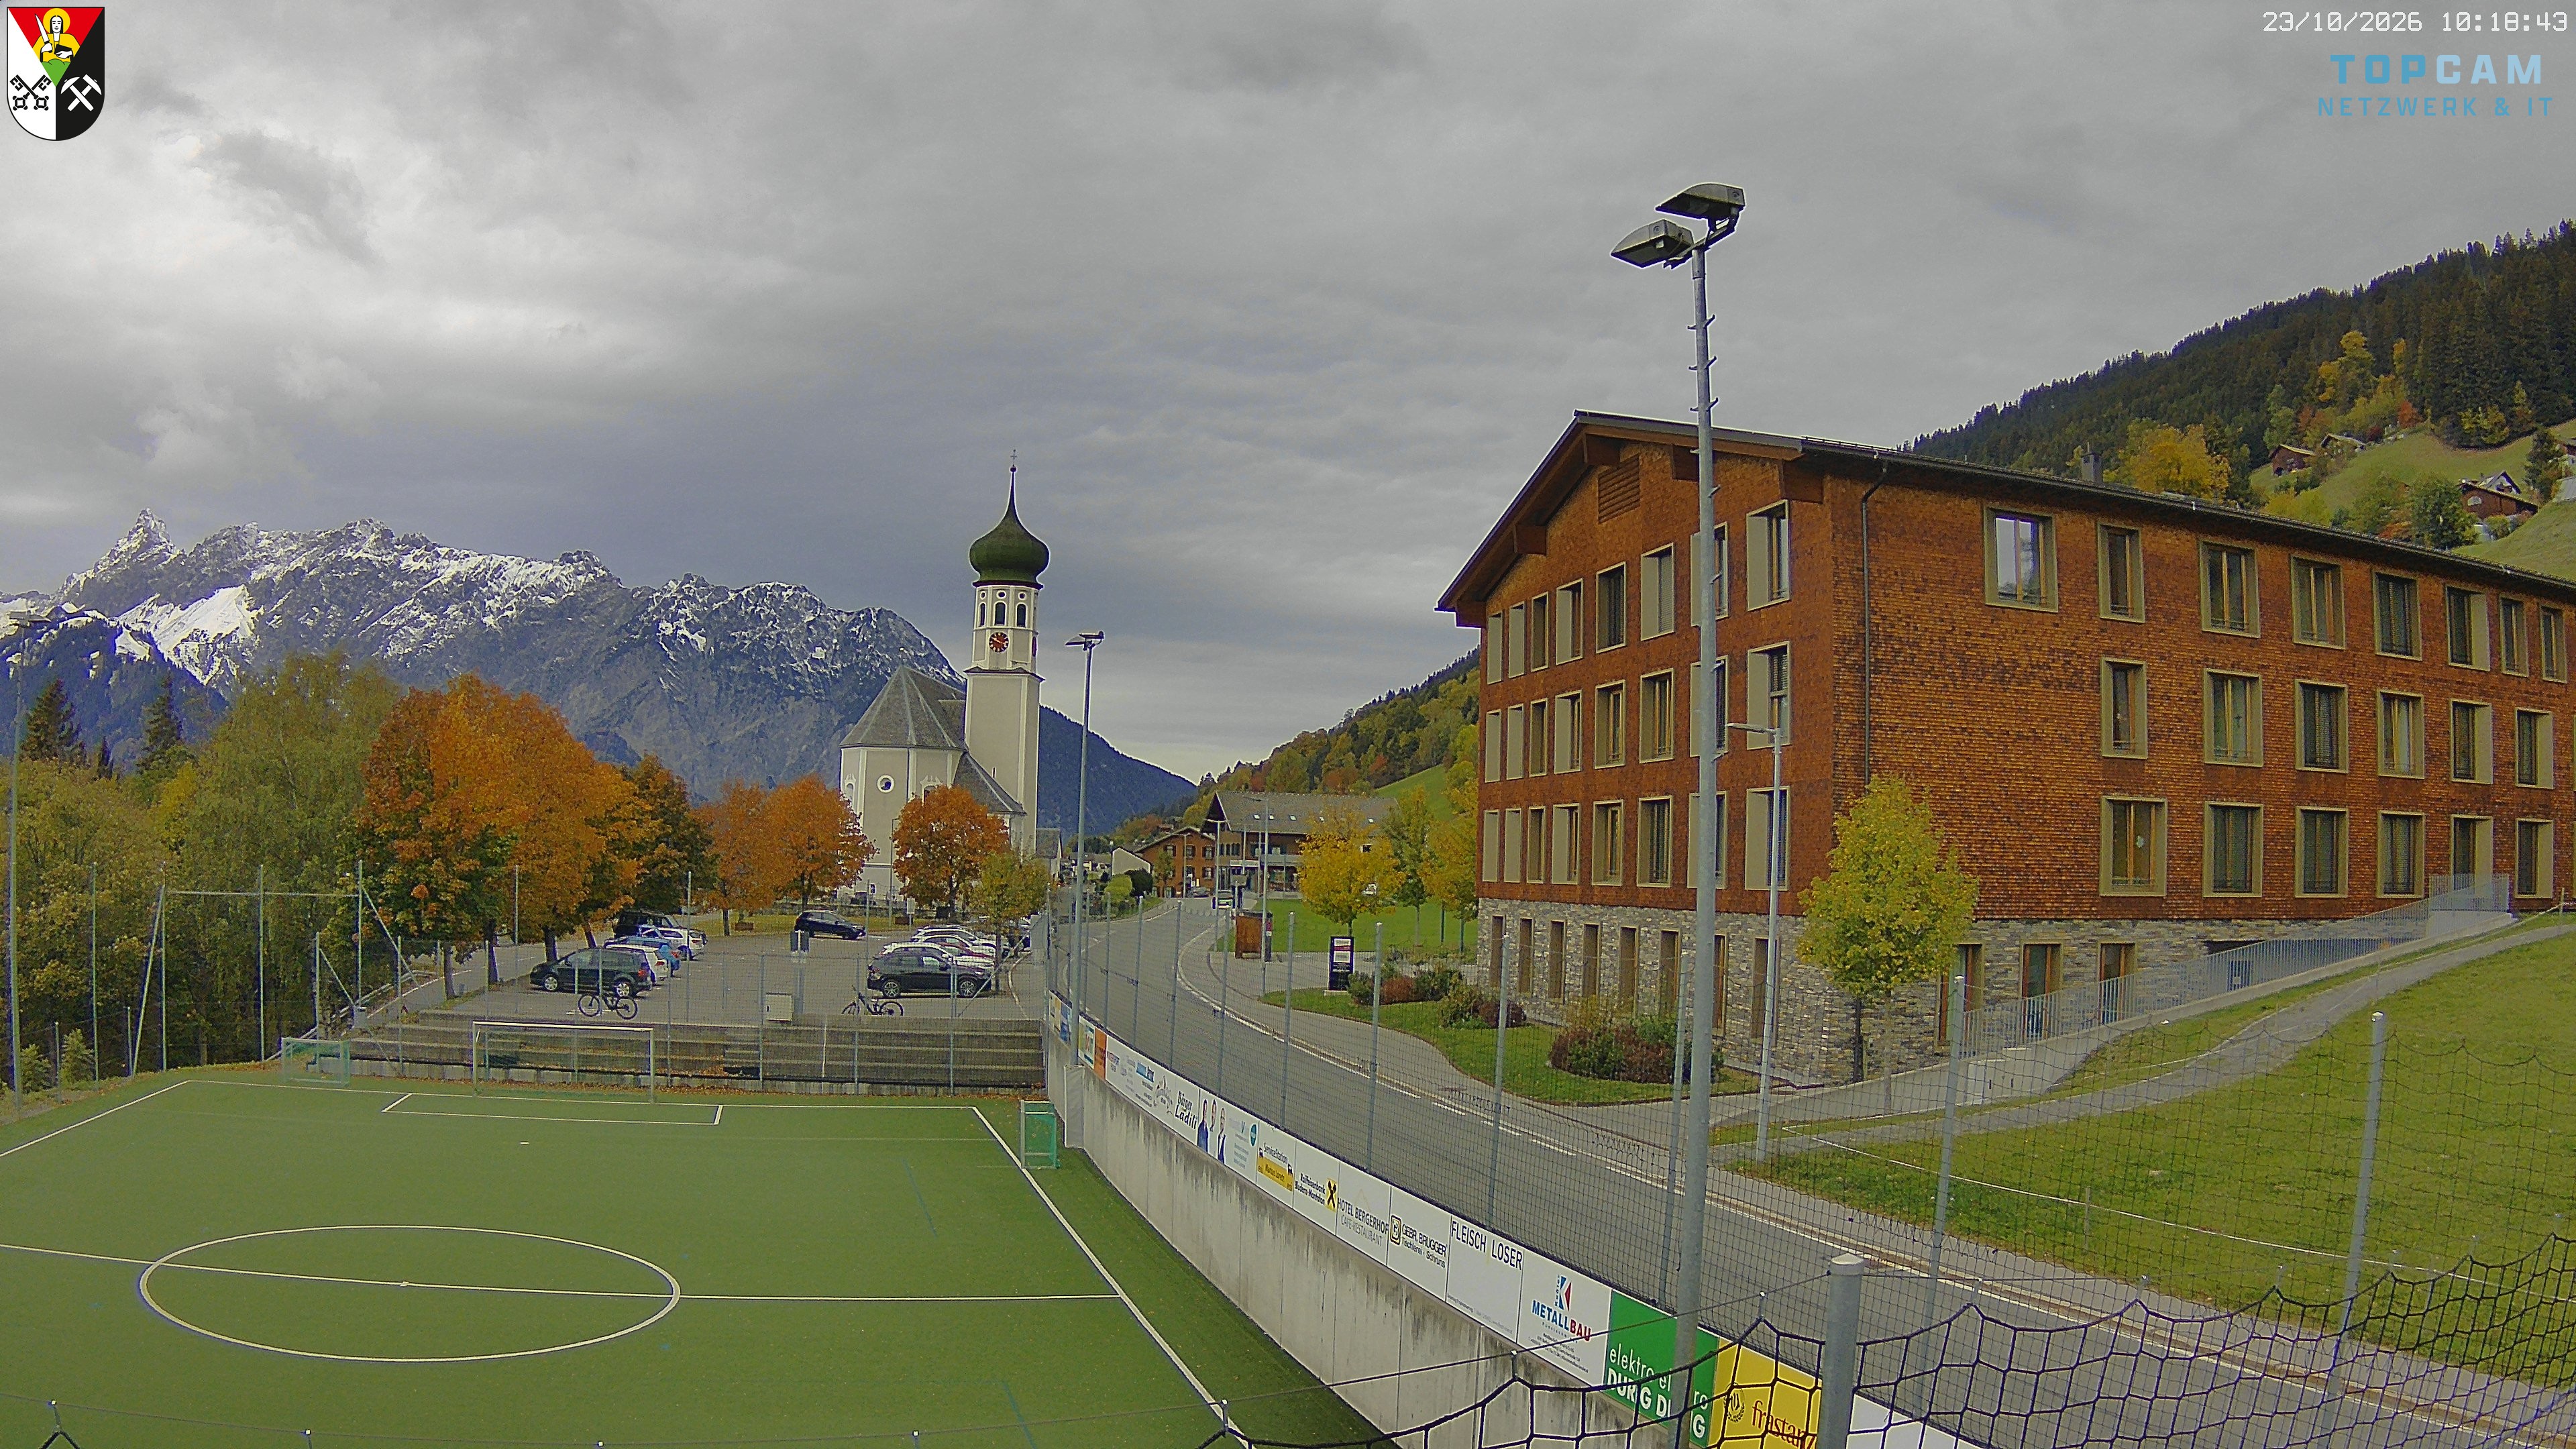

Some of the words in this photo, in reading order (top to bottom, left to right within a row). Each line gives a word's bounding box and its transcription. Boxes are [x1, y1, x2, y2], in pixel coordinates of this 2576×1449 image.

[1338, 1197, 1354, 1217] HOTEL
[1355, 1207, 1389, 1235] BERGERHOF
[1419, 1232, 1447, 1257] BRUGGER
[1451, 1220, 1487, 1253] FLEISCH
[1491, 1239, 1523, 1271] LOSER
[1532, 1300, 1592, 1342] METALLBAU
